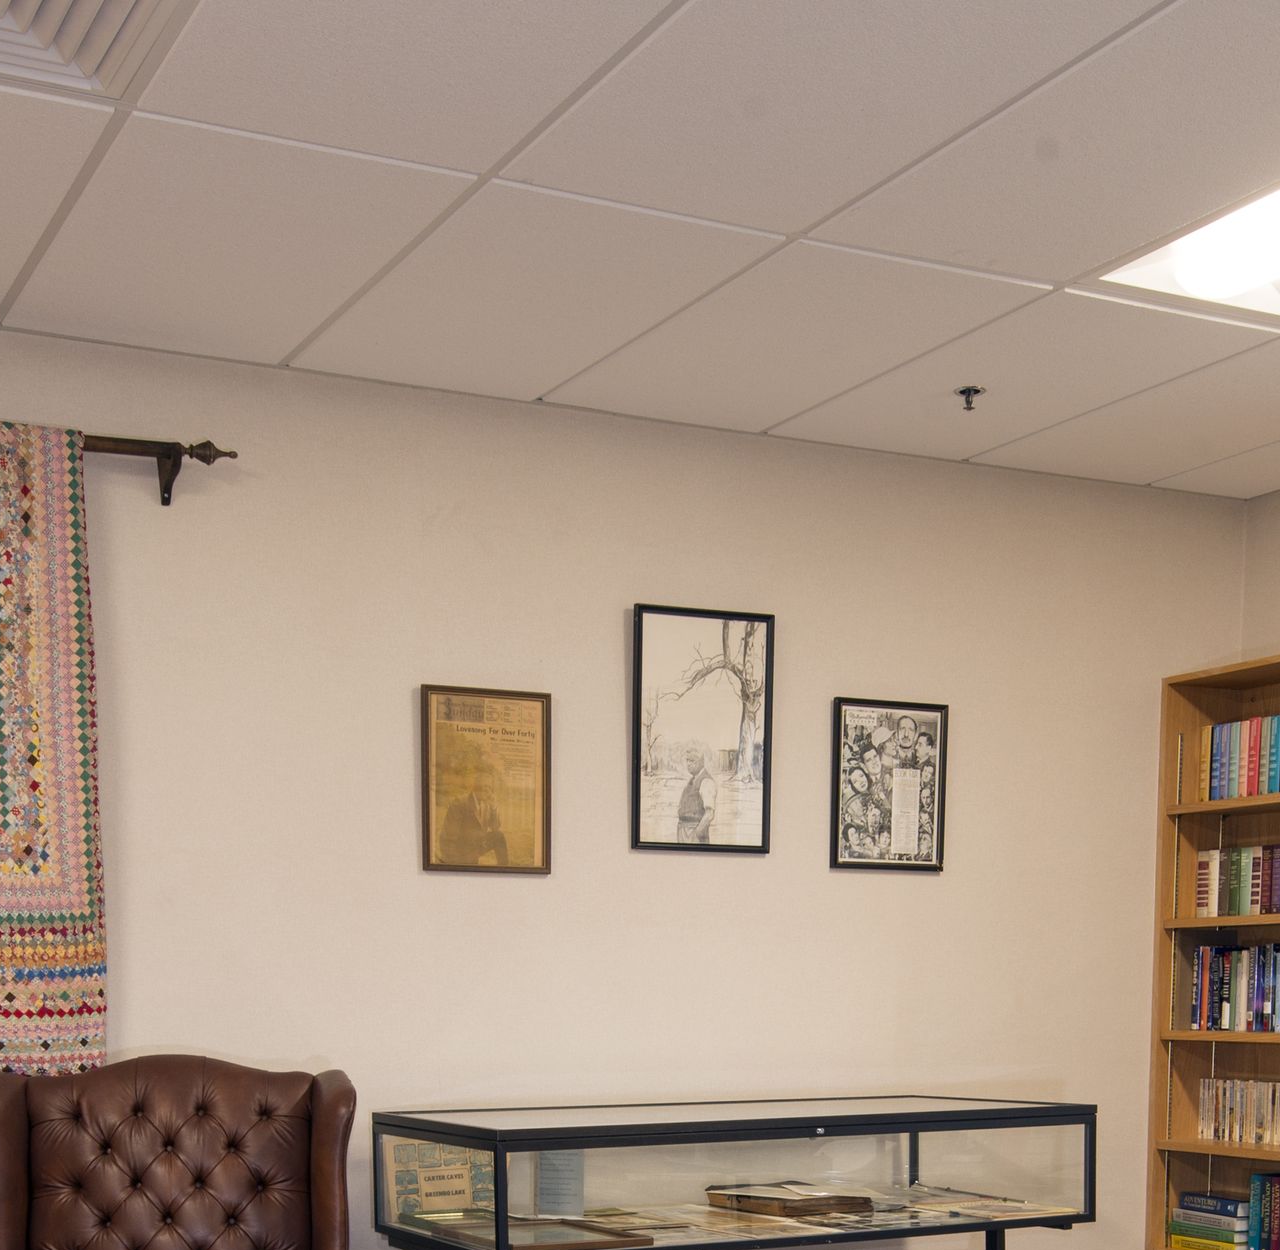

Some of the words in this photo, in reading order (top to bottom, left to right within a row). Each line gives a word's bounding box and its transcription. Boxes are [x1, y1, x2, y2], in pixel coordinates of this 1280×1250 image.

[456, 725, 487, 734] Lovesong
[502, 728, 515, 736] Over
[518, 729, 535, 738] Forty
